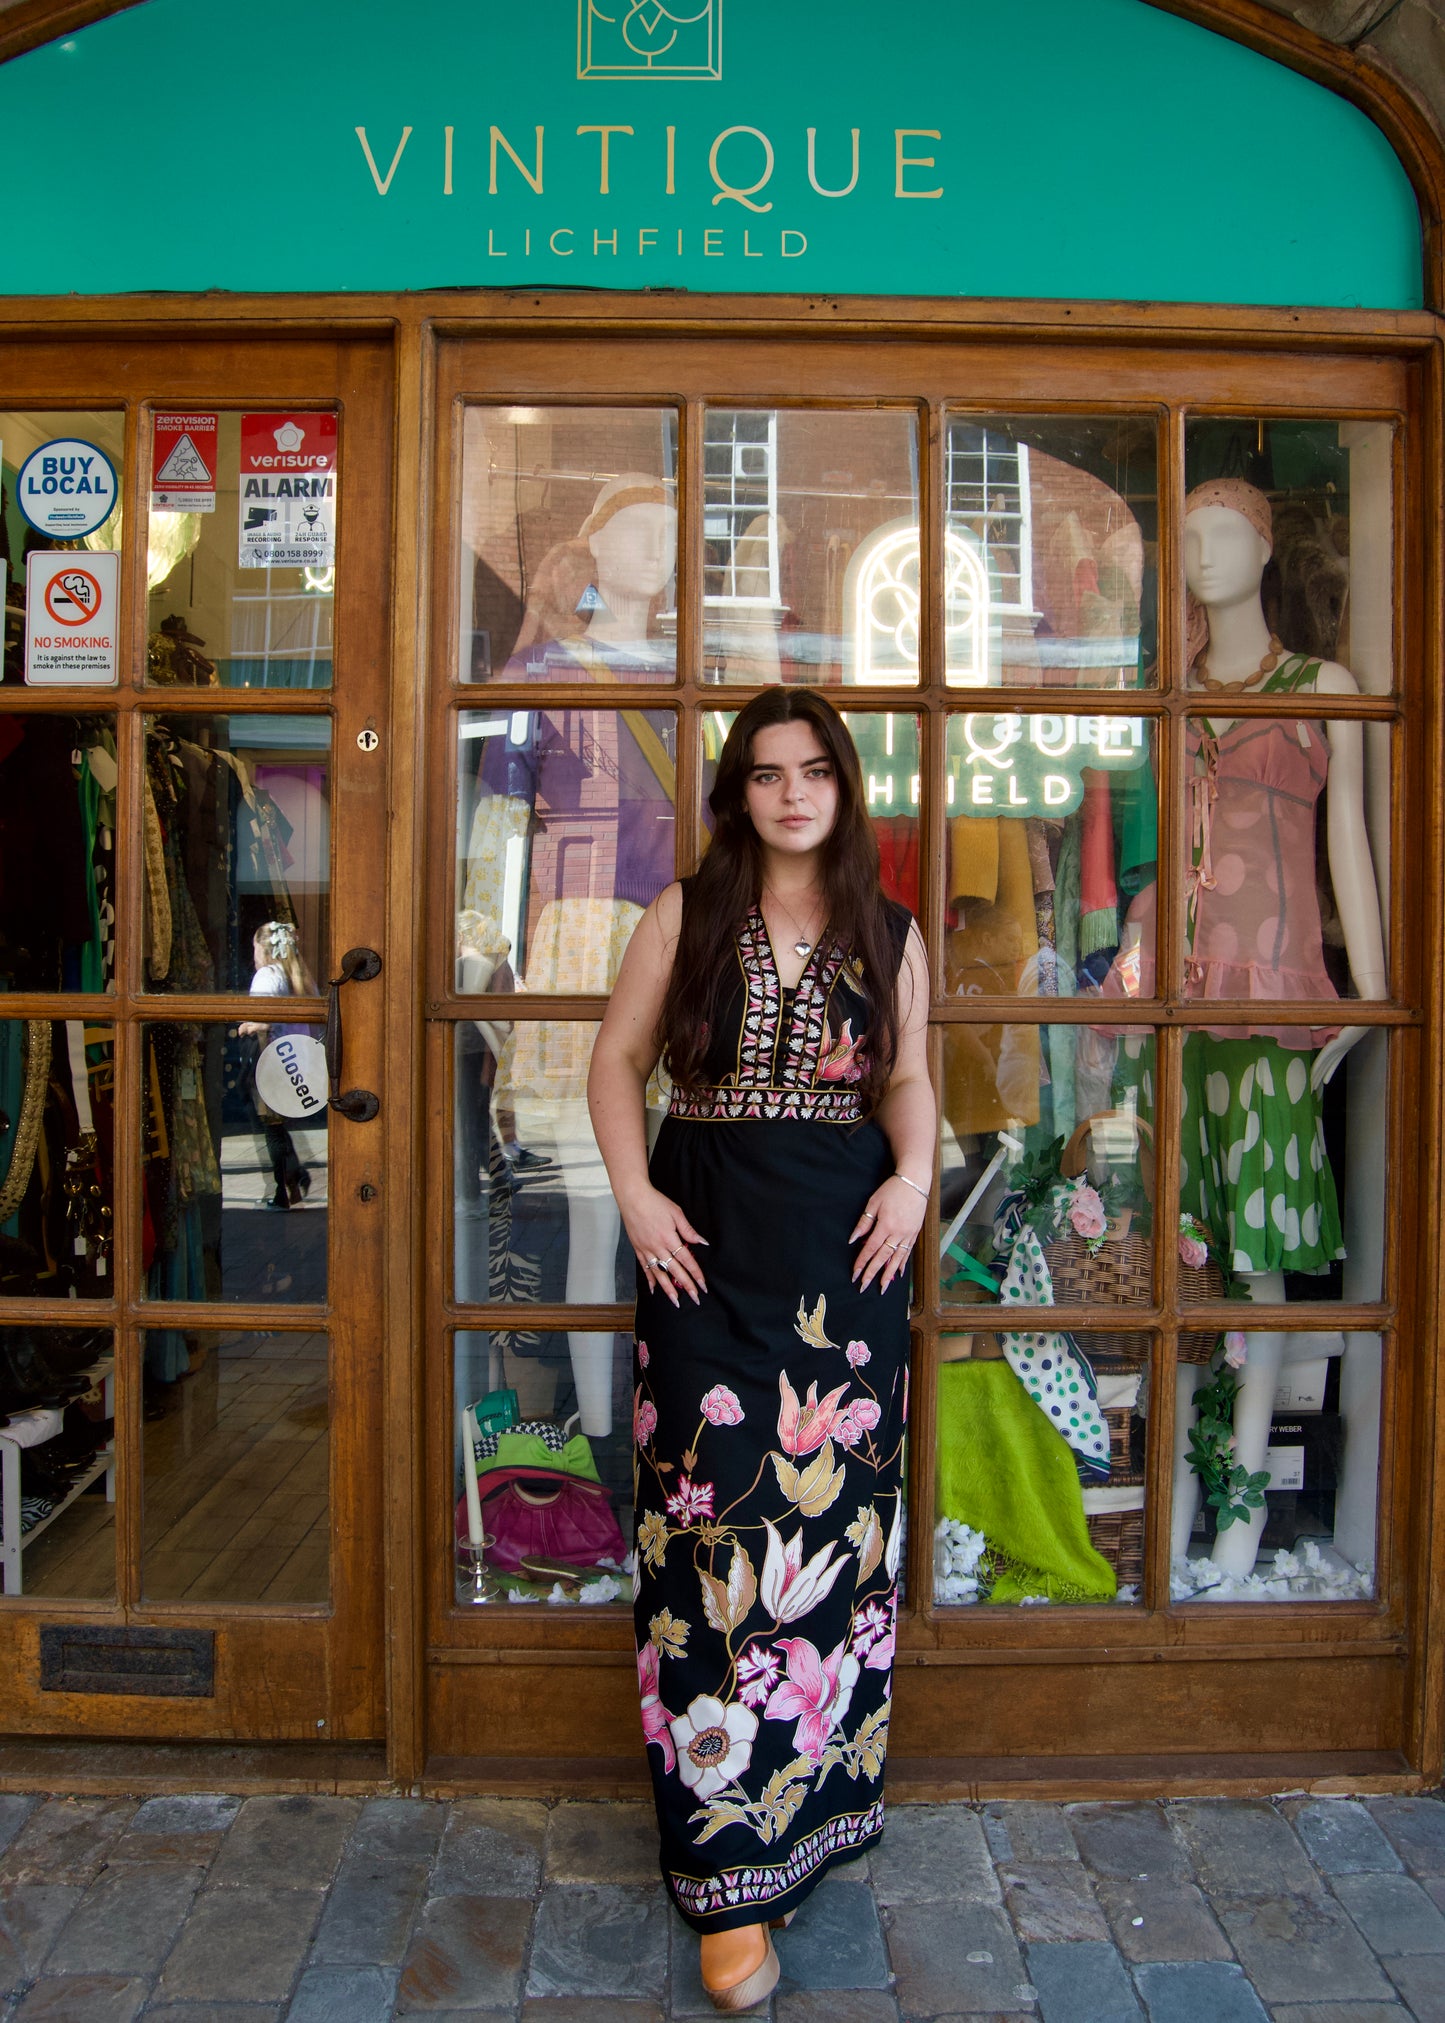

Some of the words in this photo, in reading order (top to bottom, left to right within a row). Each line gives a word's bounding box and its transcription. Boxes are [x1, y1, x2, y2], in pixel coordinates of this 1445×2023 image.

[354, 125, 945, 214] VINTIQUE
[488, 228, 808, 257] LICHFIELD
[156, 416, 216, 425] zerovision
[156, 424, 183, 432] SMOKE
[184, 424, 215, 432] BARRIER
[42, 456, 95, 475] BUY
[250, 455, 328, 467] verisure
[28, 476, 108, 495] LOCAL
[244, 478, 333, 498] ALARM
[34, 636, 52, 648] NO
[54, 636, 112, 648] SMOKING.
[50, 654, 74, 663] against
[81, 662, 110, 670] premises
[867, 774, 1071, 805] HFIELD
[276, 1041, 319, 1110] Closed
